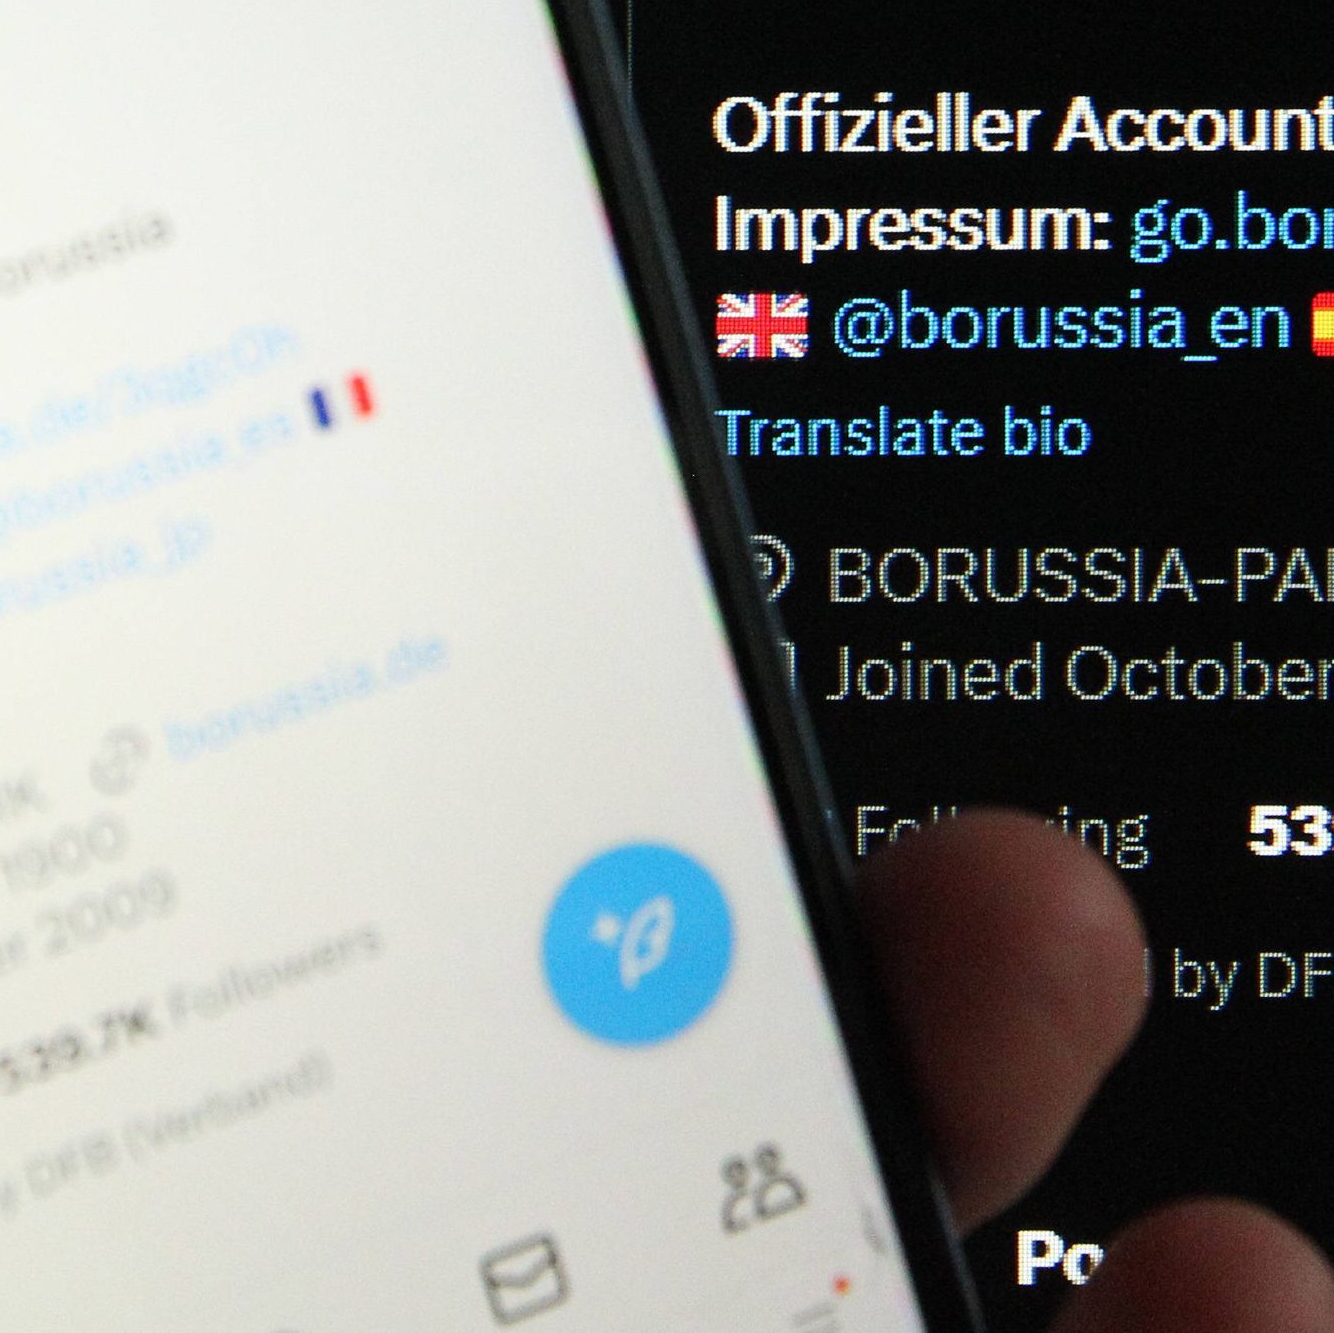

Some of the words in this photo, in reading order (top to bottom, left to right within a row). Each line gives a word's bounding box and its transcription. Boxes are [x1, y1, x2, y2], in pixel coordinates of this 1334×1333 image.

[712, 91, 1044, 153] Offizieller
[715, 195, 1113, 264] Impressum:
[834, 288, 1292, 362] @borussia_en
[713, 405, 986, 457] Translate
[1004, 405, 1093, 457] bio
[826, 641, 1043, 701] Joined
[1174, 948, 1239, 1011] by
